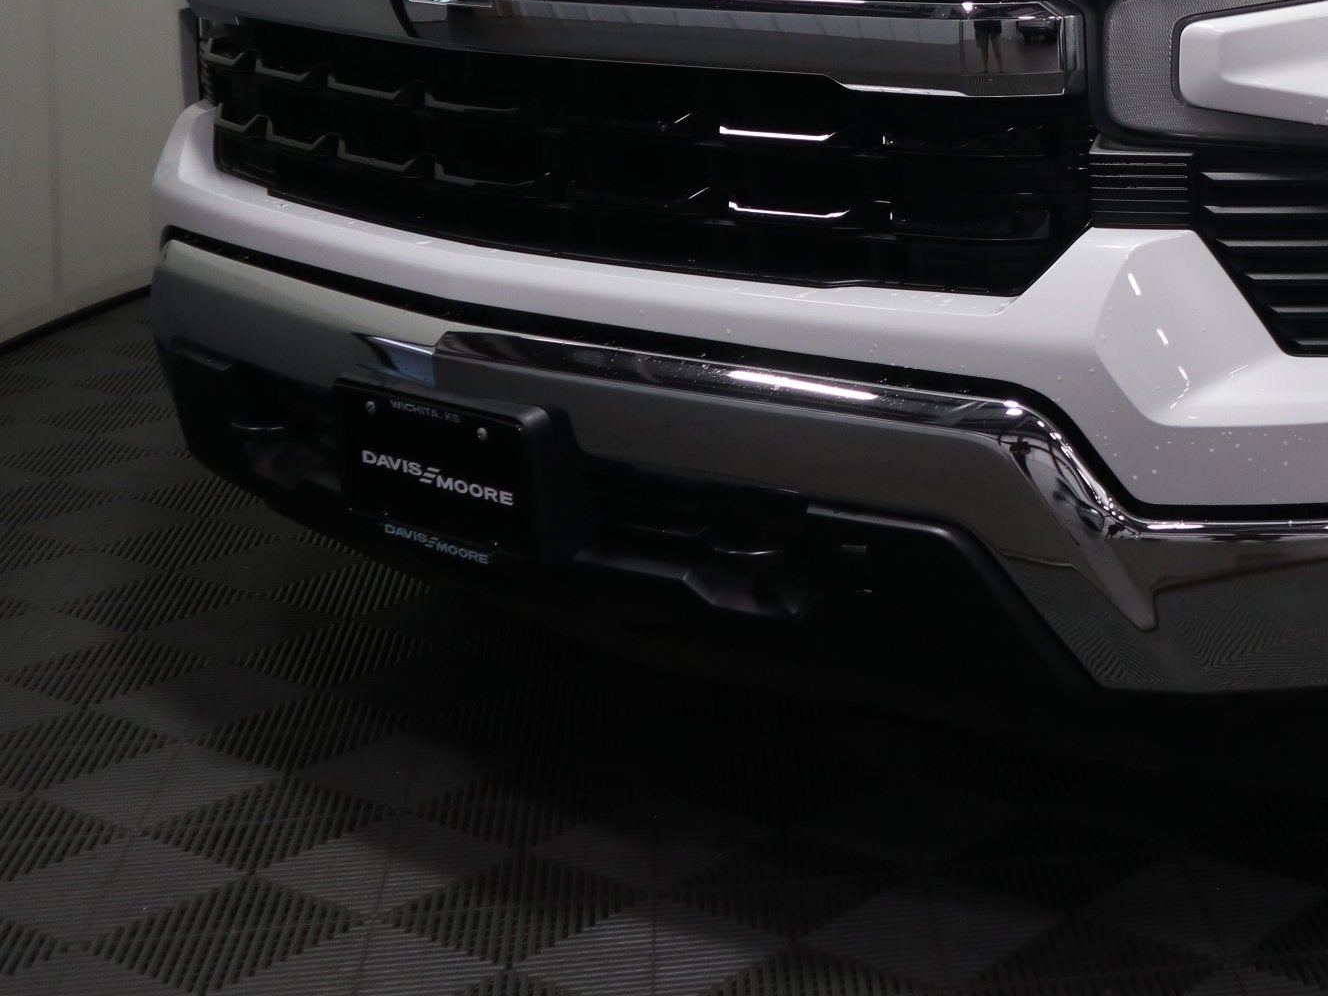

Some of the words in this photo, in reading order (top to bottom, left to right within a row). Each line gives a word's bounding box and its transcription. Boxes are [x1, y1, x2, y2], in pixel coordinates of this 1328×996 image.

[362, 450, 422, 476] DAVIS
[436, 475, 514, 506] MOORE
[384, 523, 427, 544] DAVIS
[436, 543, 489, 565] MOORE
